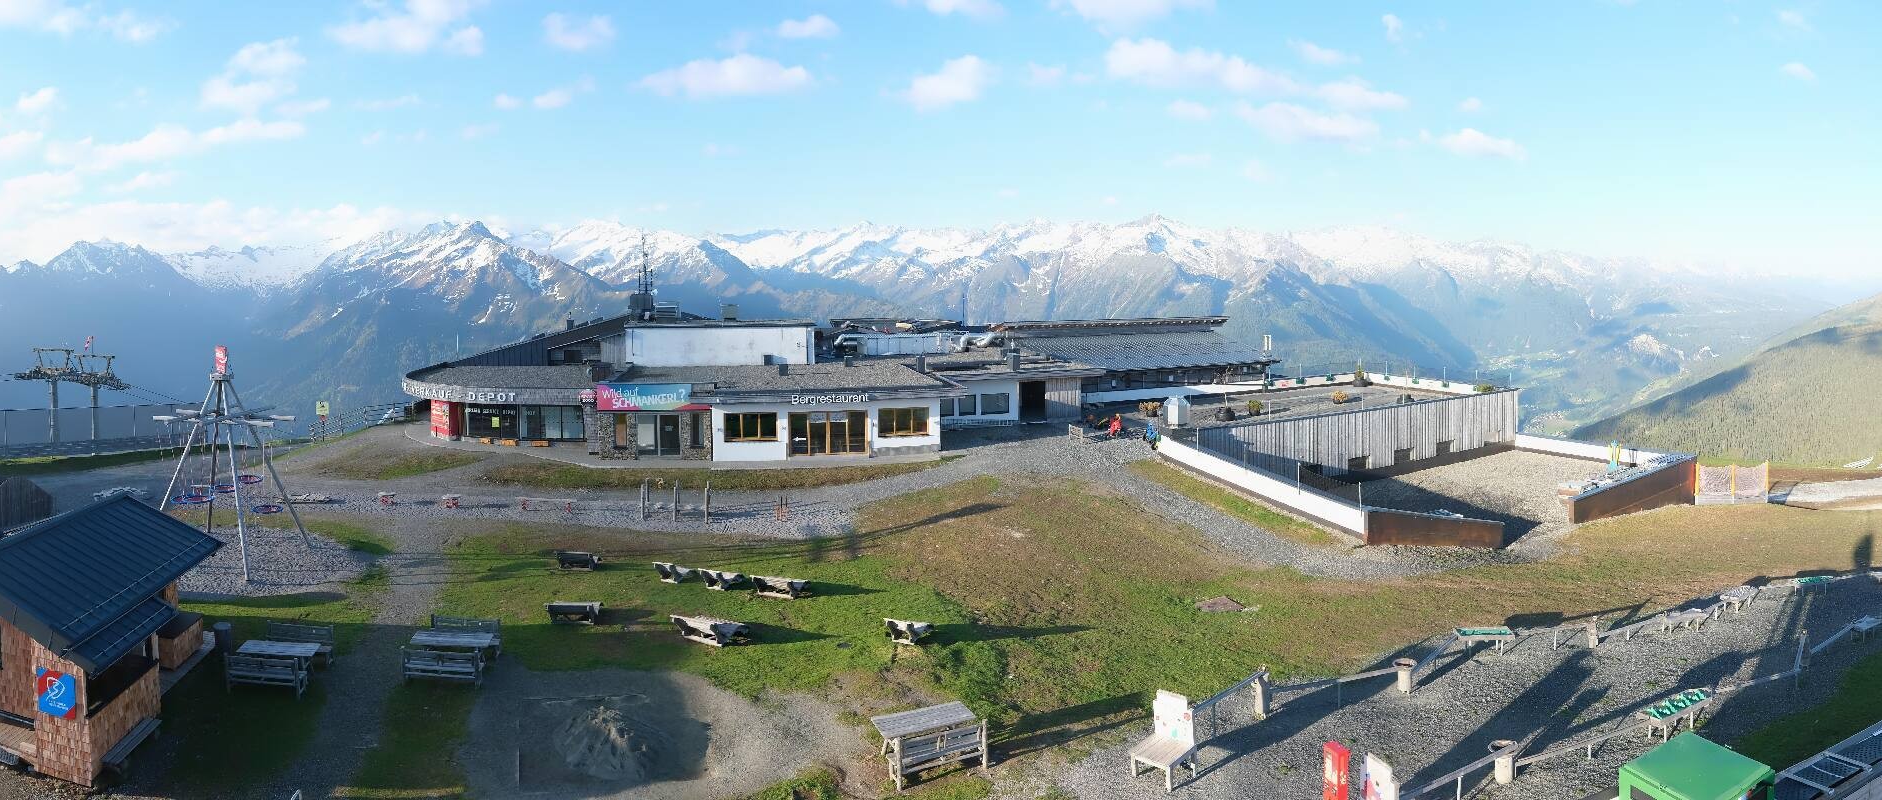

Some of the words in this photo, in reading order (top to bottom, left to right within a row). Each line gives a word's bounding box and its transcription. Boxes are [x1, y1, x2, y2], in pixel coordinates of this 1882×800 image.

[468, 391, 515, 401] DEPOT
[602, 387, 622, 399] Wild
[623, 387, 639, 398] auf
[612, 388, 686, 409] SCHMANKERL?
[791, 393, 869, 405] Bergrestaurant
